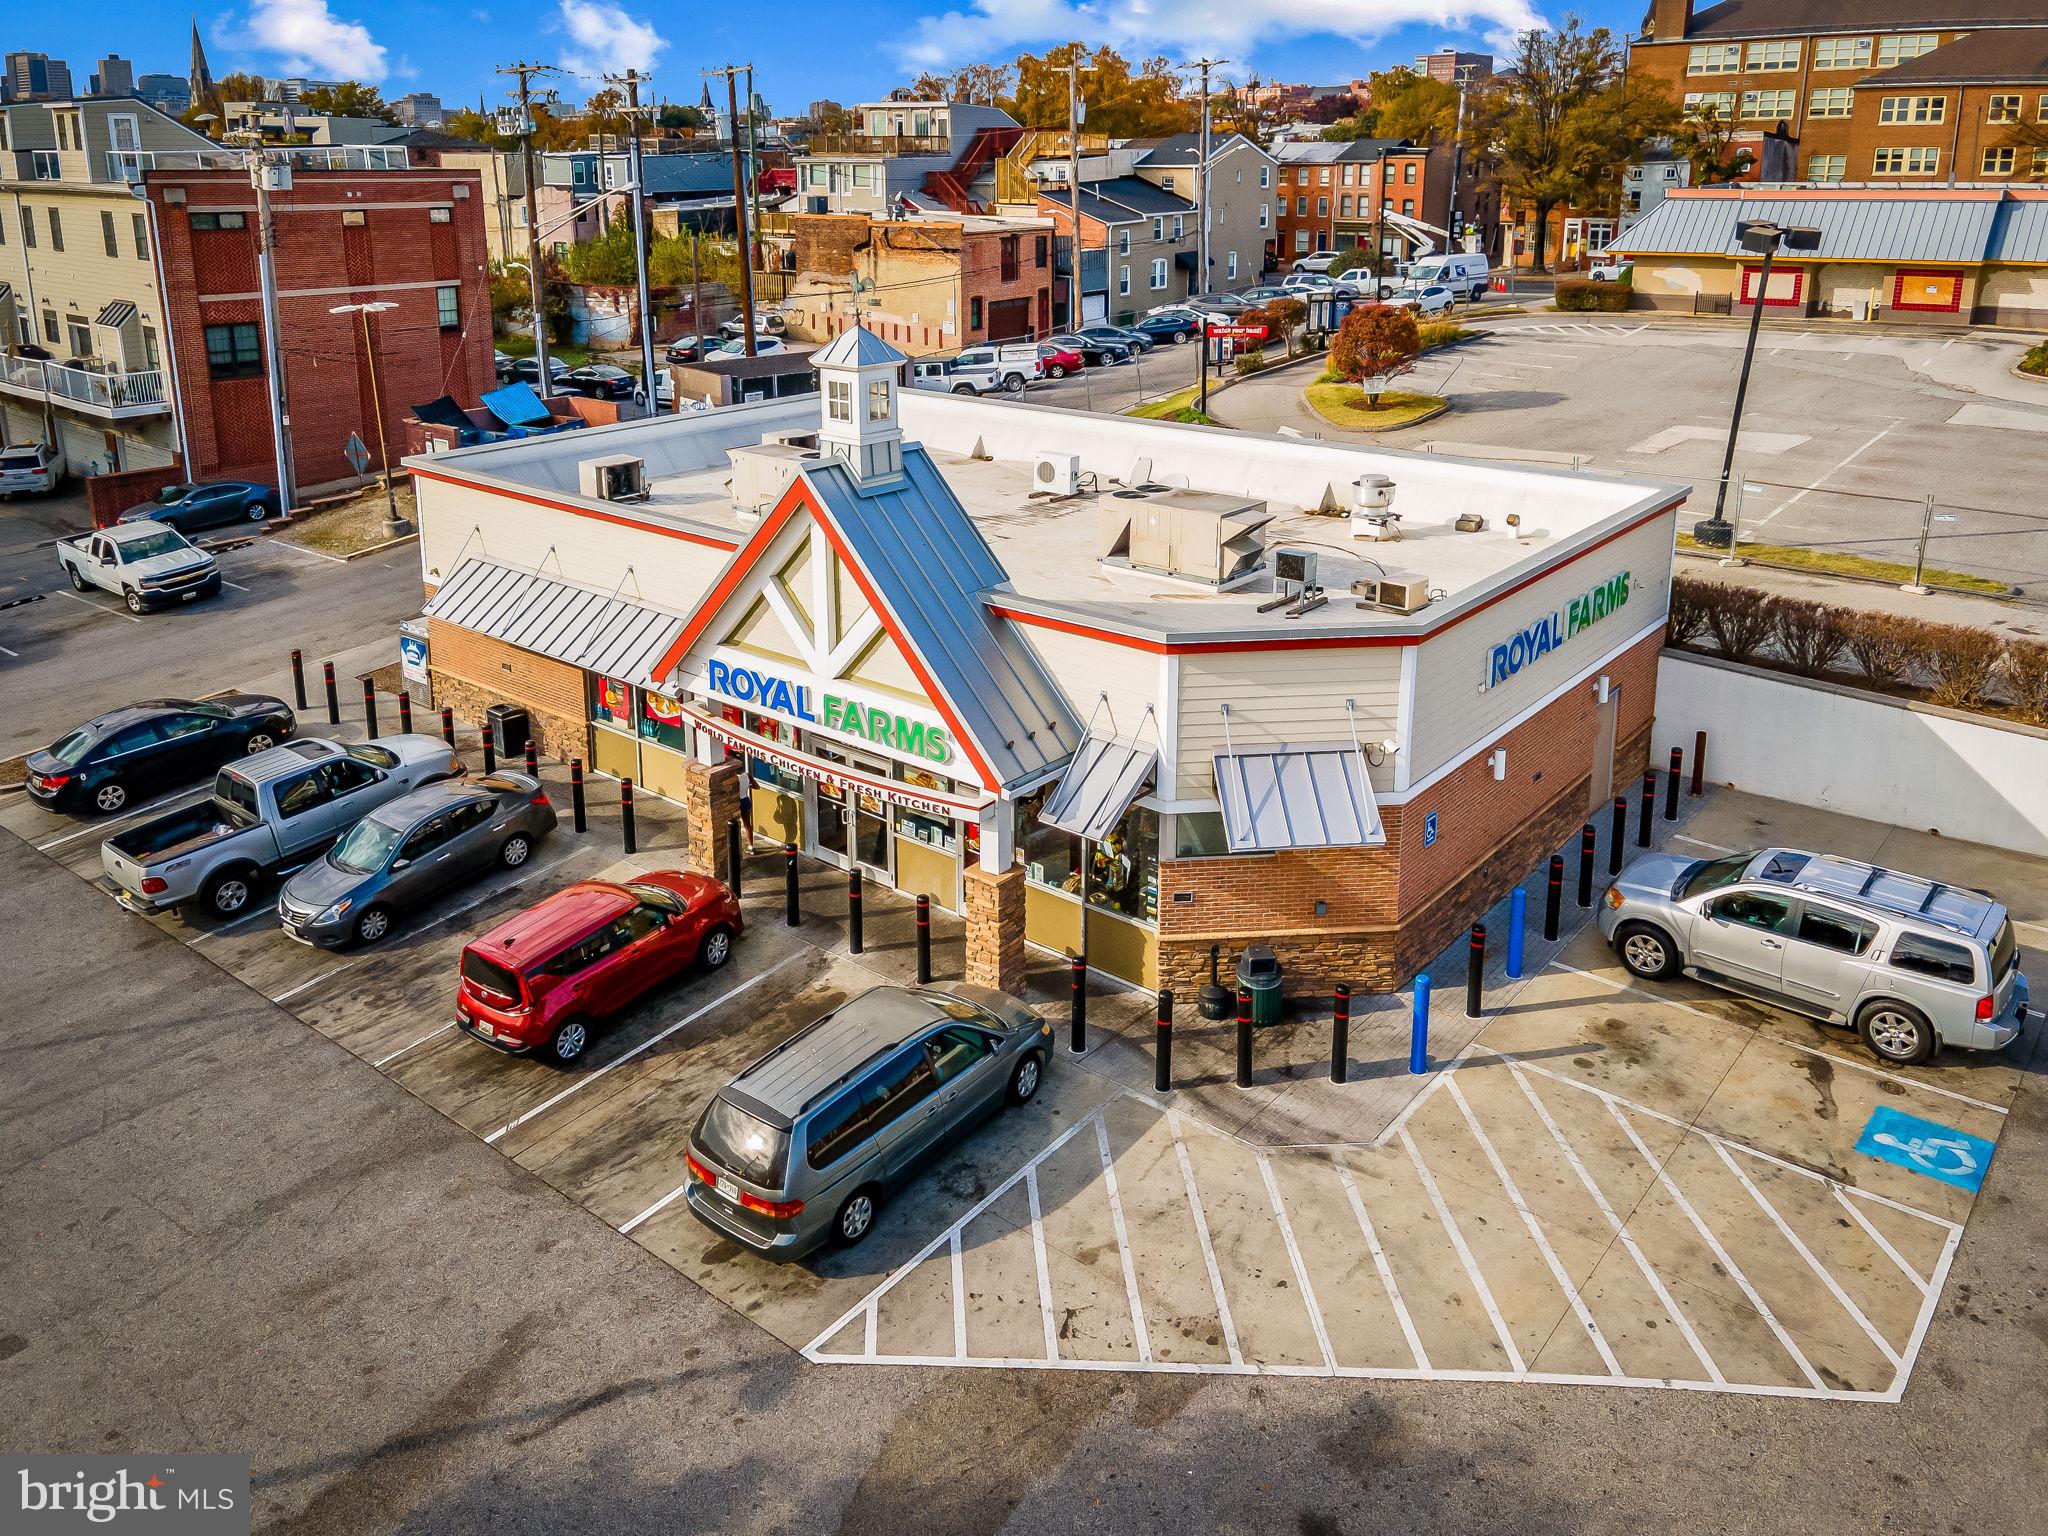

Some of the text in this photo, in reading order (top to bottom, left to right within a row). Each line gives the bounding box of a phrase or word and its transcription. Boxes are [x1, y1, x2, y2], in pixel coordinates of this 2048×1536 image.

[1491, 571, 1631, 688] ROYAL FARMS
[709, 659, 950, 763] ROYAL FARMS
[694, 720, 951, 816] WORLD FAMOUS CHICKEN & FRESH KITCHEN
